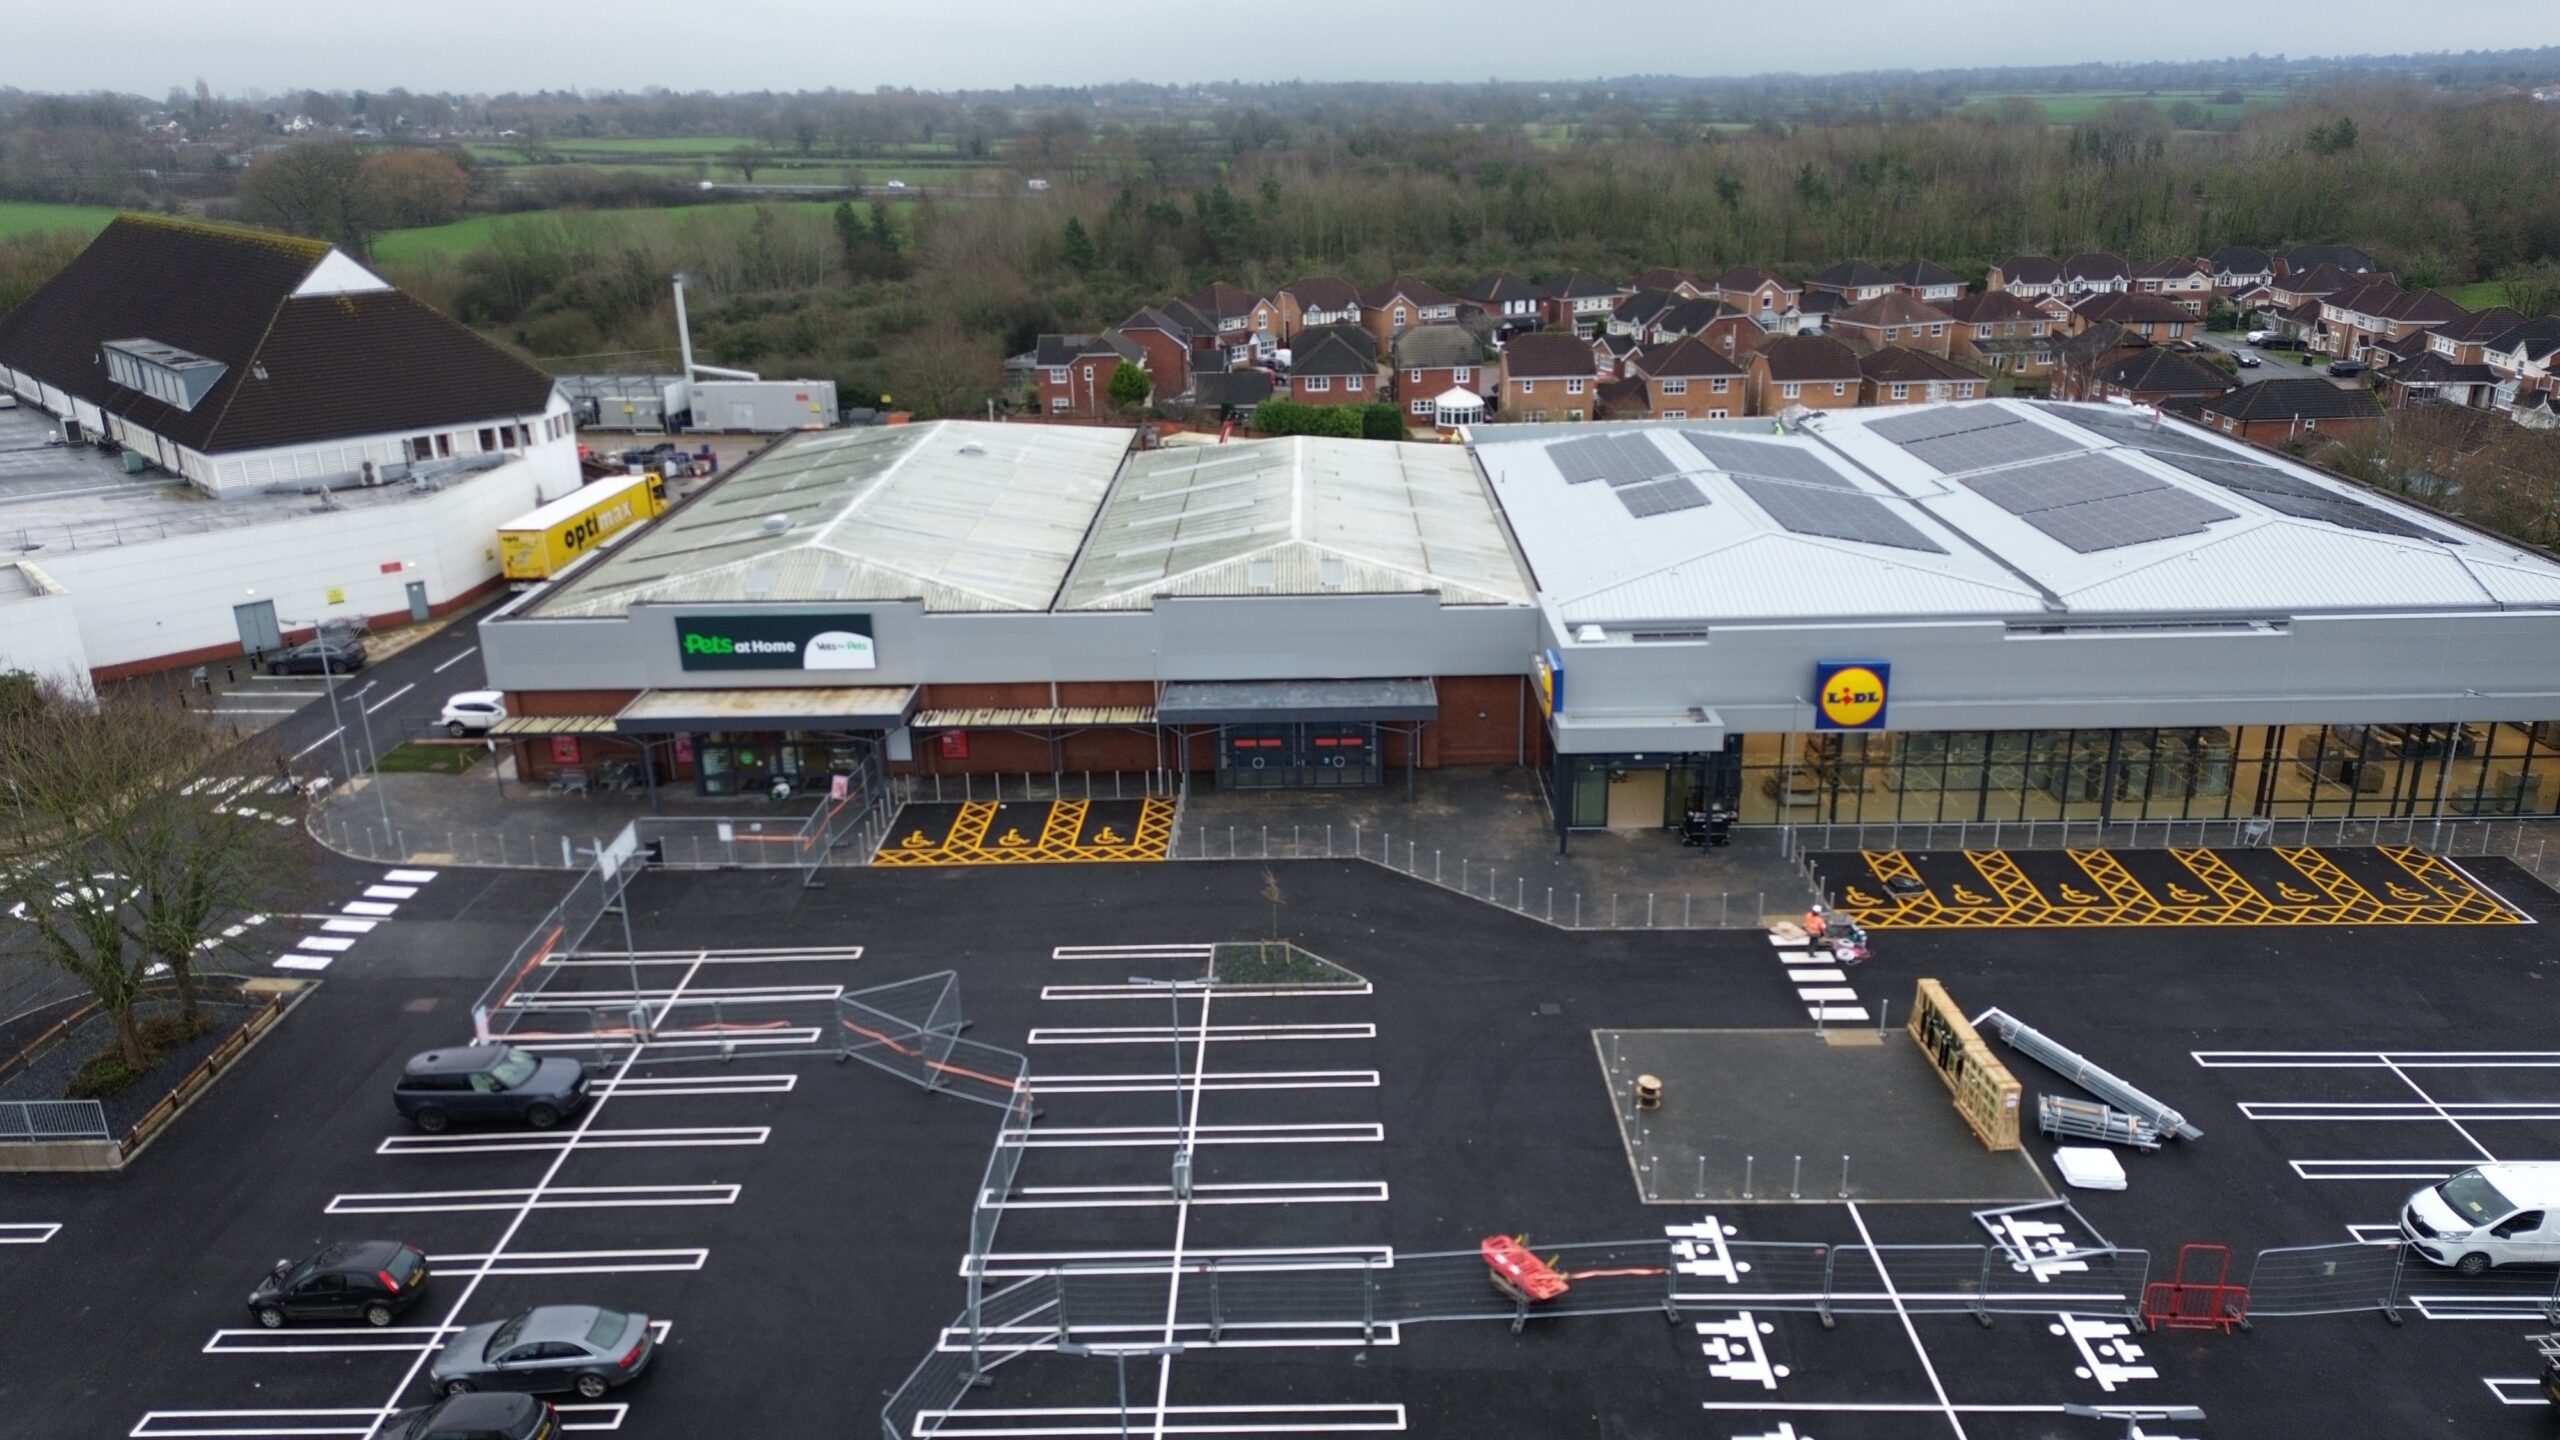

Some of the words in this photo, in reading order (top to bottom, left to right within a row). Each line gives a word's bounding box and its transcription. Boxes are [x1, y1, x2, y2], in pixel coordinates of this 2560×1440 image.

[564, 500, 632, 550] optimax
[684, 633, 733, 654] Pets
[734, 641, 750, 653] at
[751, 640, 796, 653] Home
